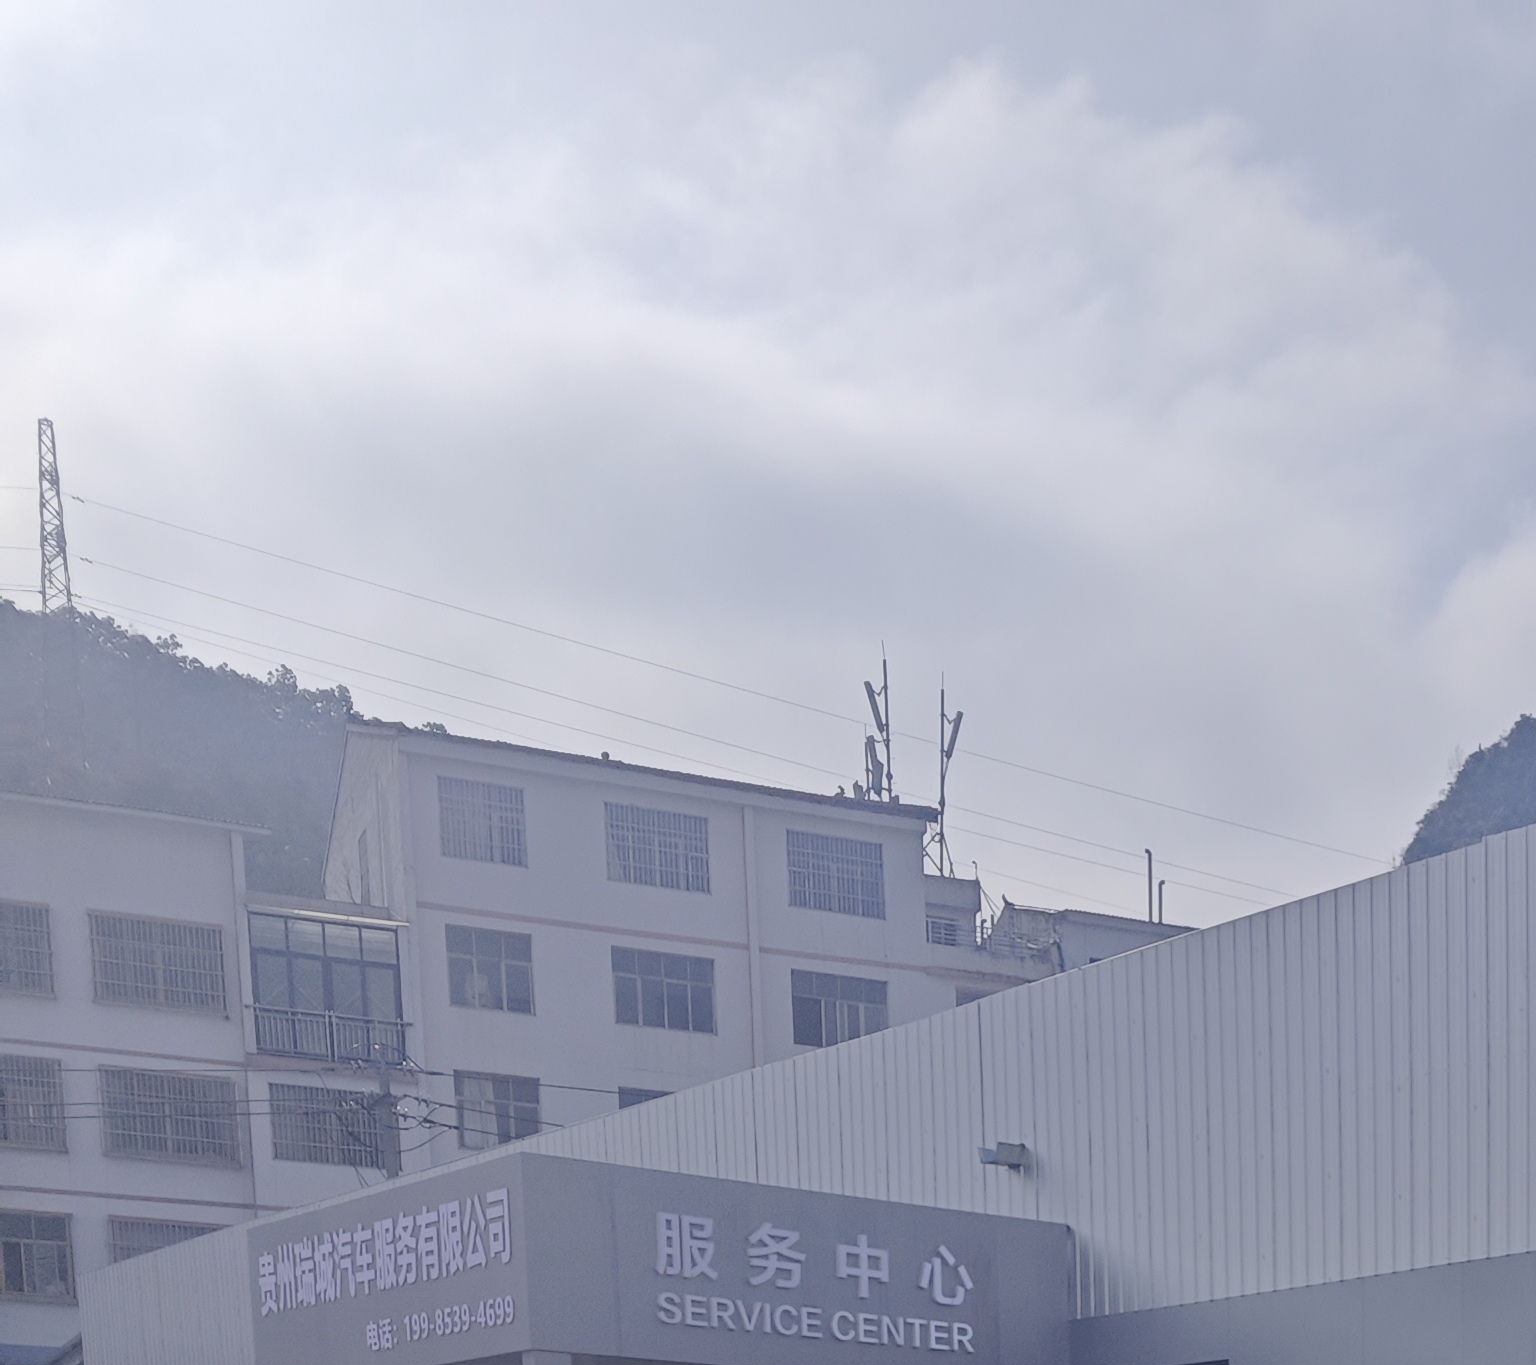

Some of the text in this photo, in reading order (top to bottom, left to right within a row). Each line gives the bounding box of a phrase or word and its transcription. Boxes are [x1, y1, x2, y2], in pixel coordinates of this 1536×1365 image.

[655, 1212, 973, 1305] 服务中心
[657, 1293, 974, 1352] SERVICE CENTER
